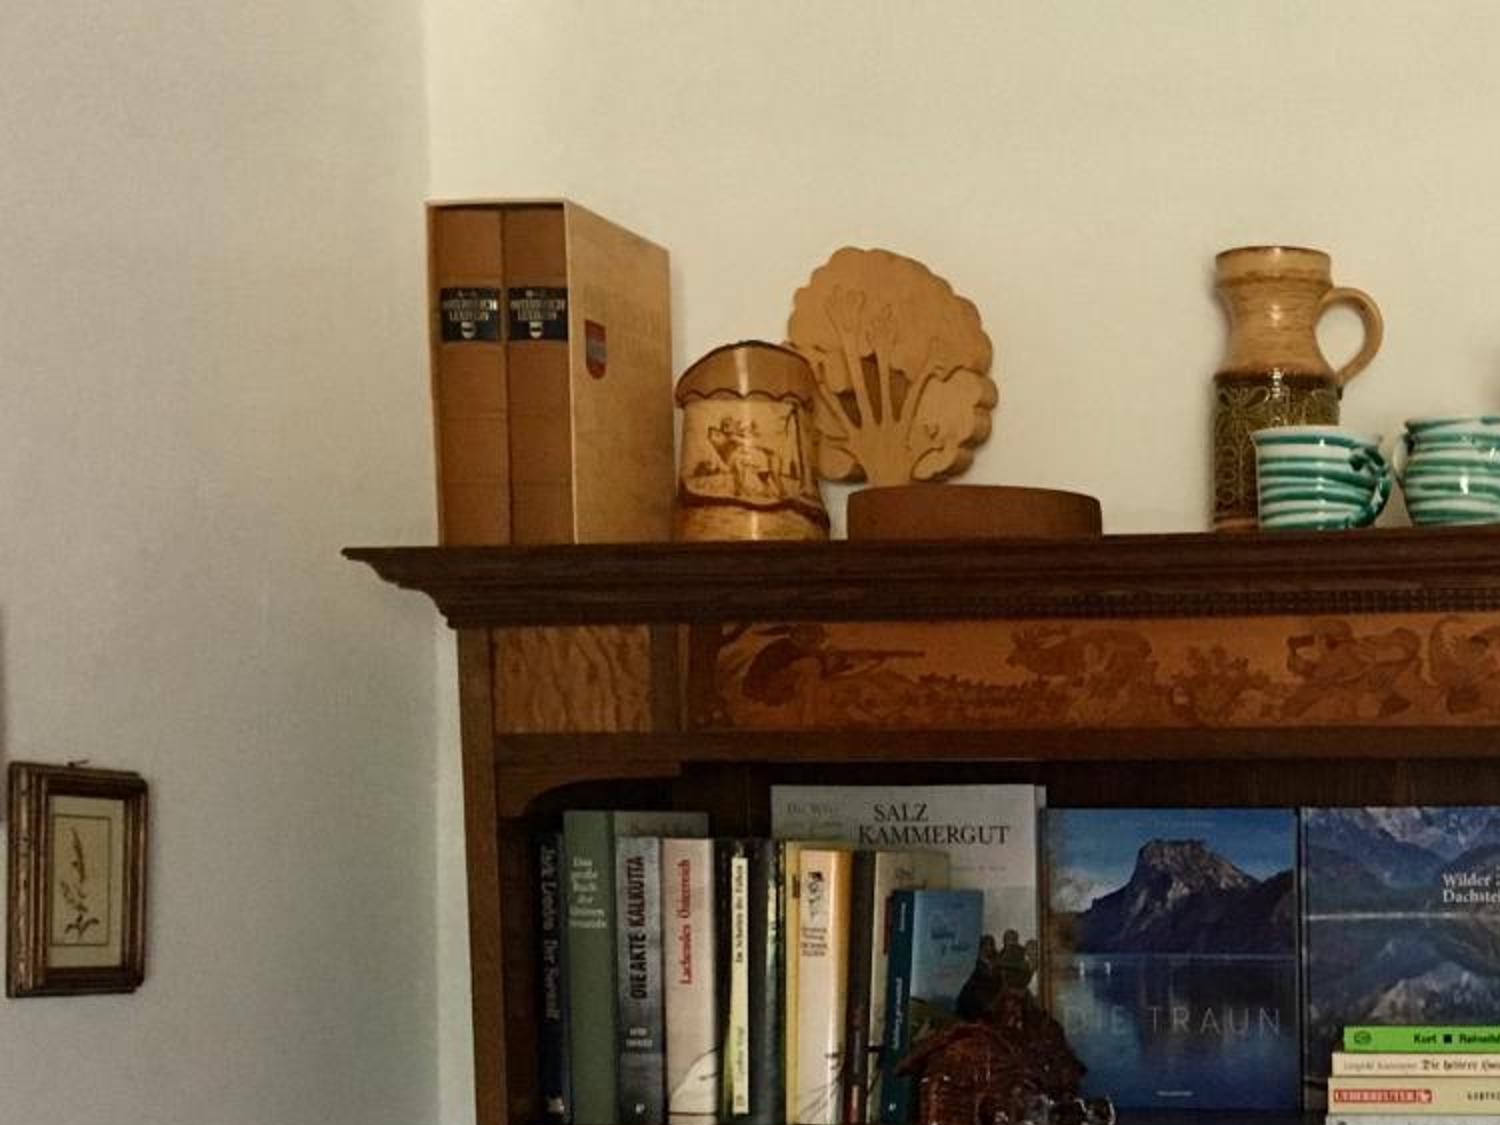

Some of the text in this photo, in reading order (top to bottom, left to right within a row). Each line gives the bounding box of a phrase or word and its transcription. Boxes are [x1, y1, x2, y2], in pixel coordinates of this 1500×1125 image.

[873, 803, 929, 823] SALZ
[859, 824, 1011, 845] KAMMERGUT
[1442, 872, 1491, 887] Wilder
[626, 856, 648, 1000] DIE AKTE KALKUTTA
[1147, 1006, 1281, 1038] TRAUN
